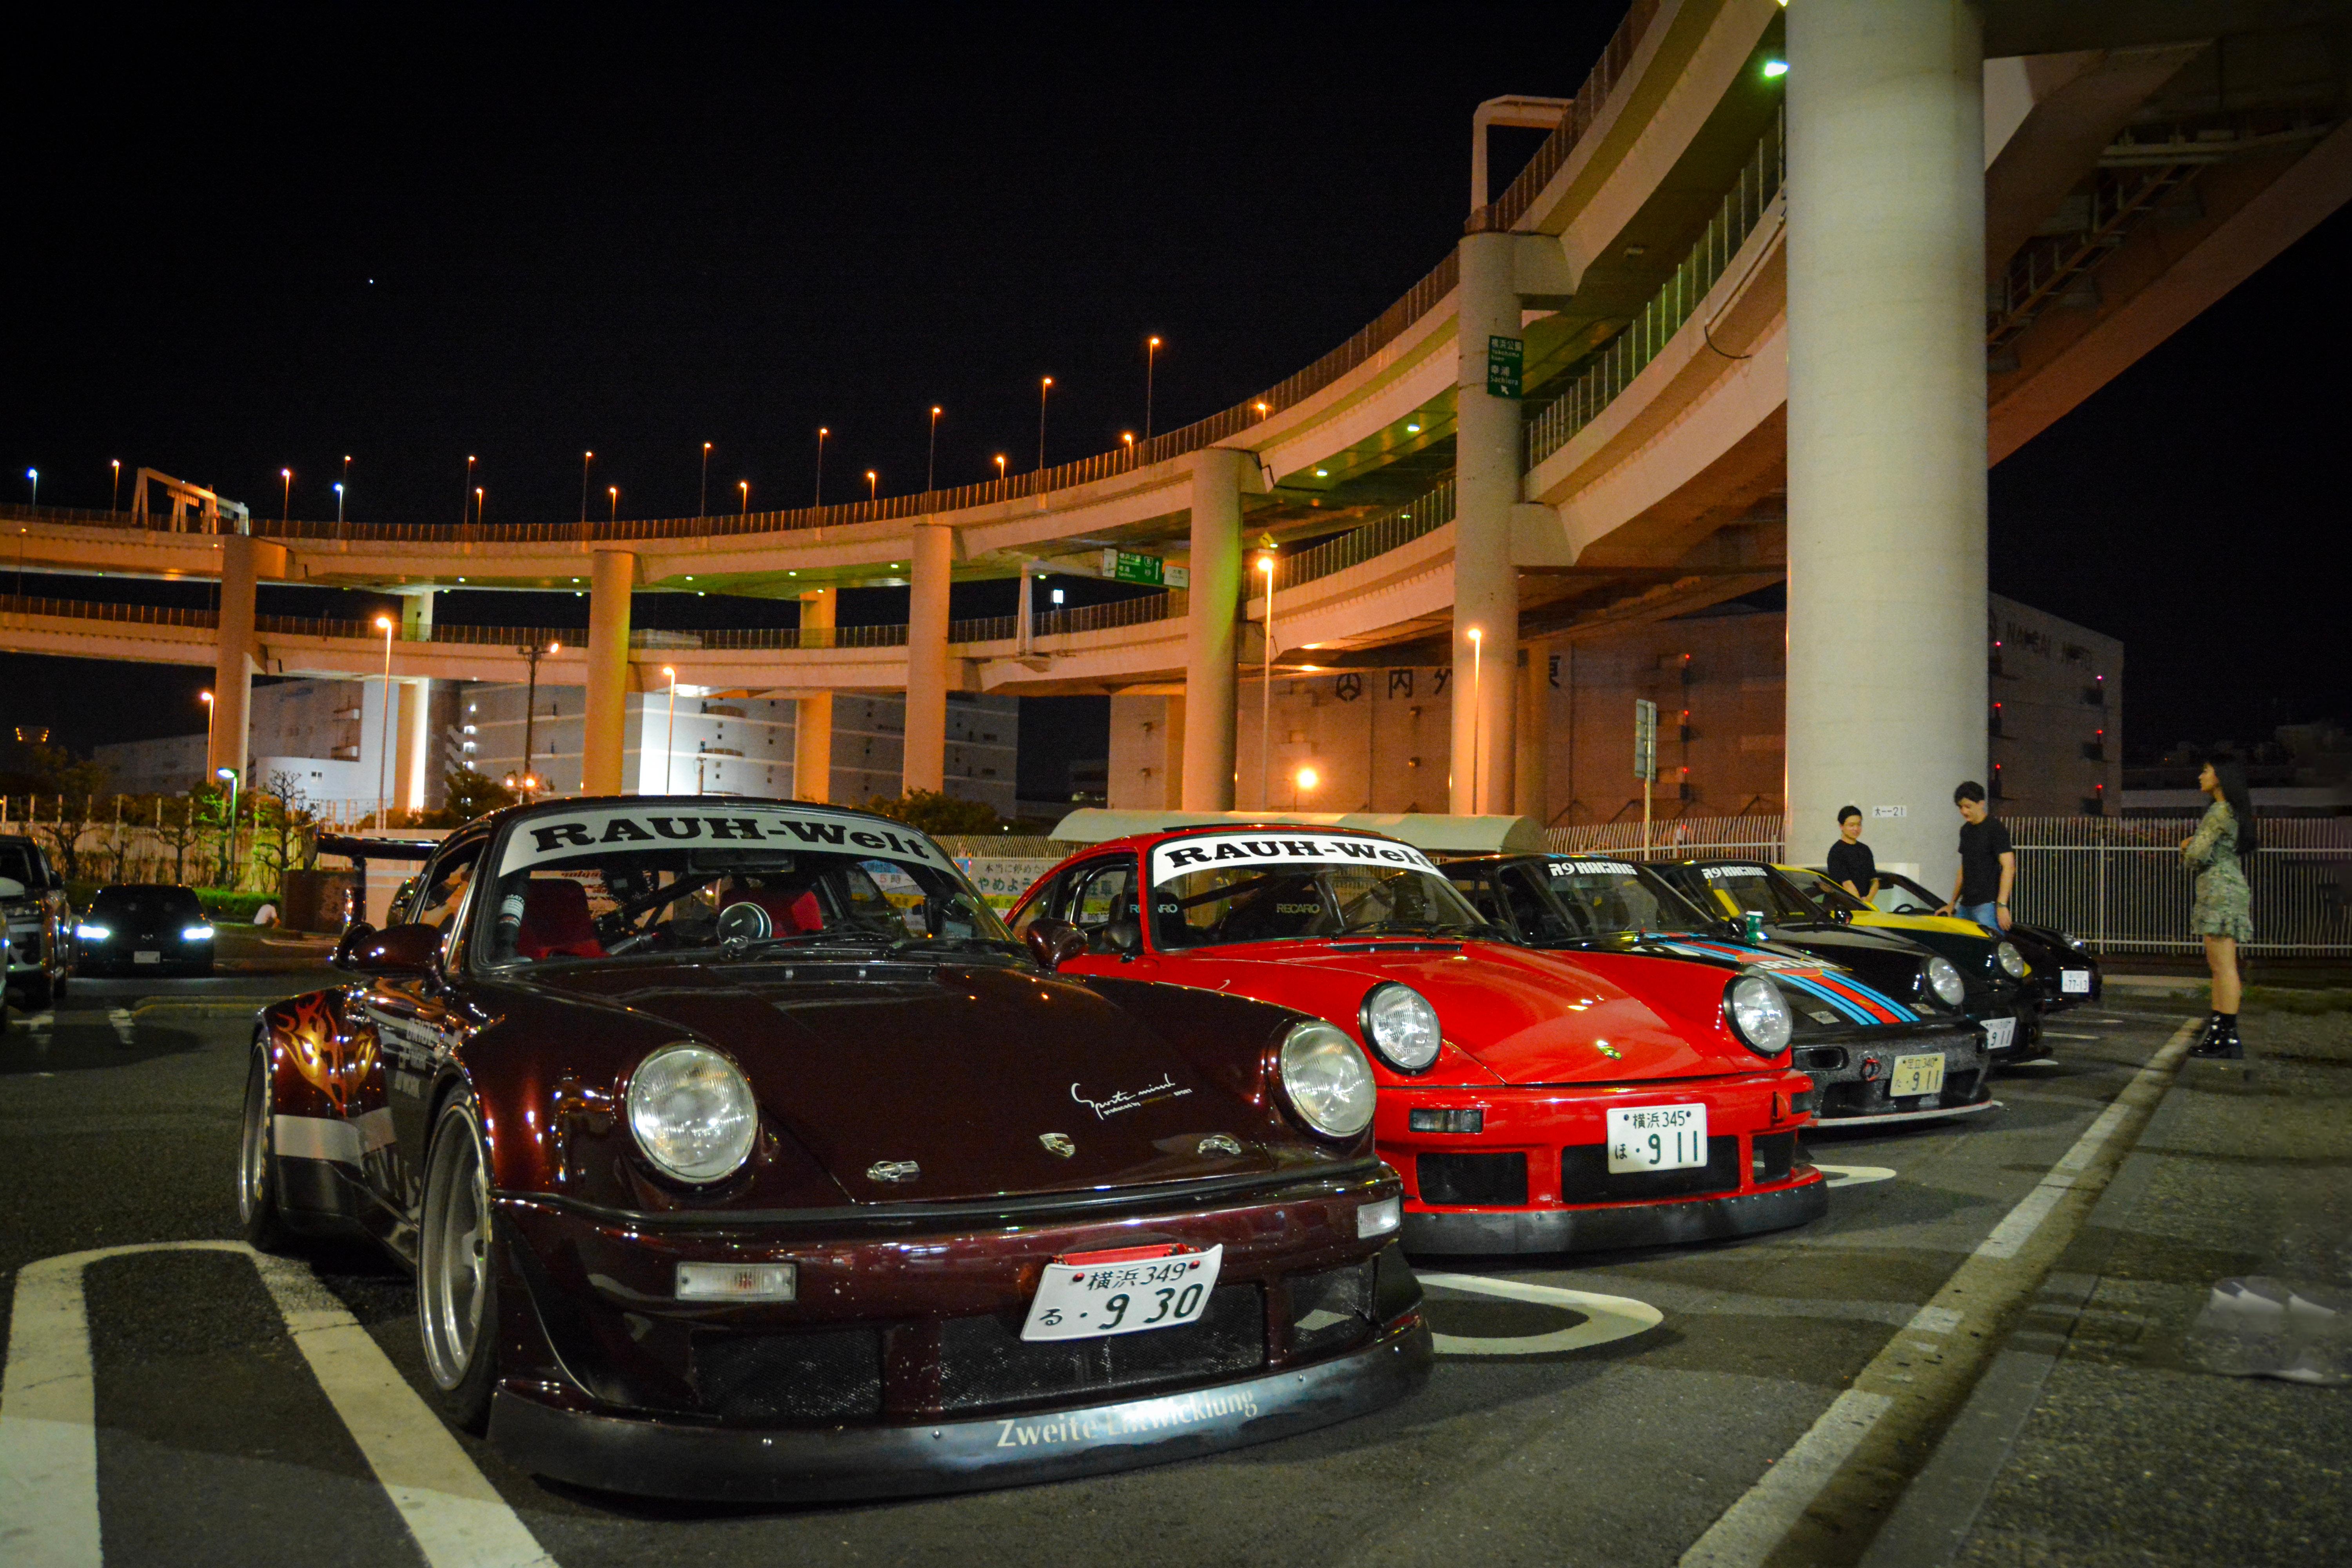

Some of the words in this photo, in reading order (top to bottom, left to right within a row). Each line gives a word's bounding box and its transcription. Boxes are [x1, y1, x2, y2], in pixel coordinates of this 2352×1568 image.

[530, 816, 931, 860] RAUH-Welt
[1165, 841, 1434, 870] RAUH-Welt
[1577, 862, 1638, 875] RACING
[1724, 866, 1768, 877] RACING
[1277, 903, 1320, 914] RECARO
[1614, 1143, 1628, 1160] ほ
[1039, 1308, 1063, 1326] る
[996, 1413, 1098, 1447] Zweite
